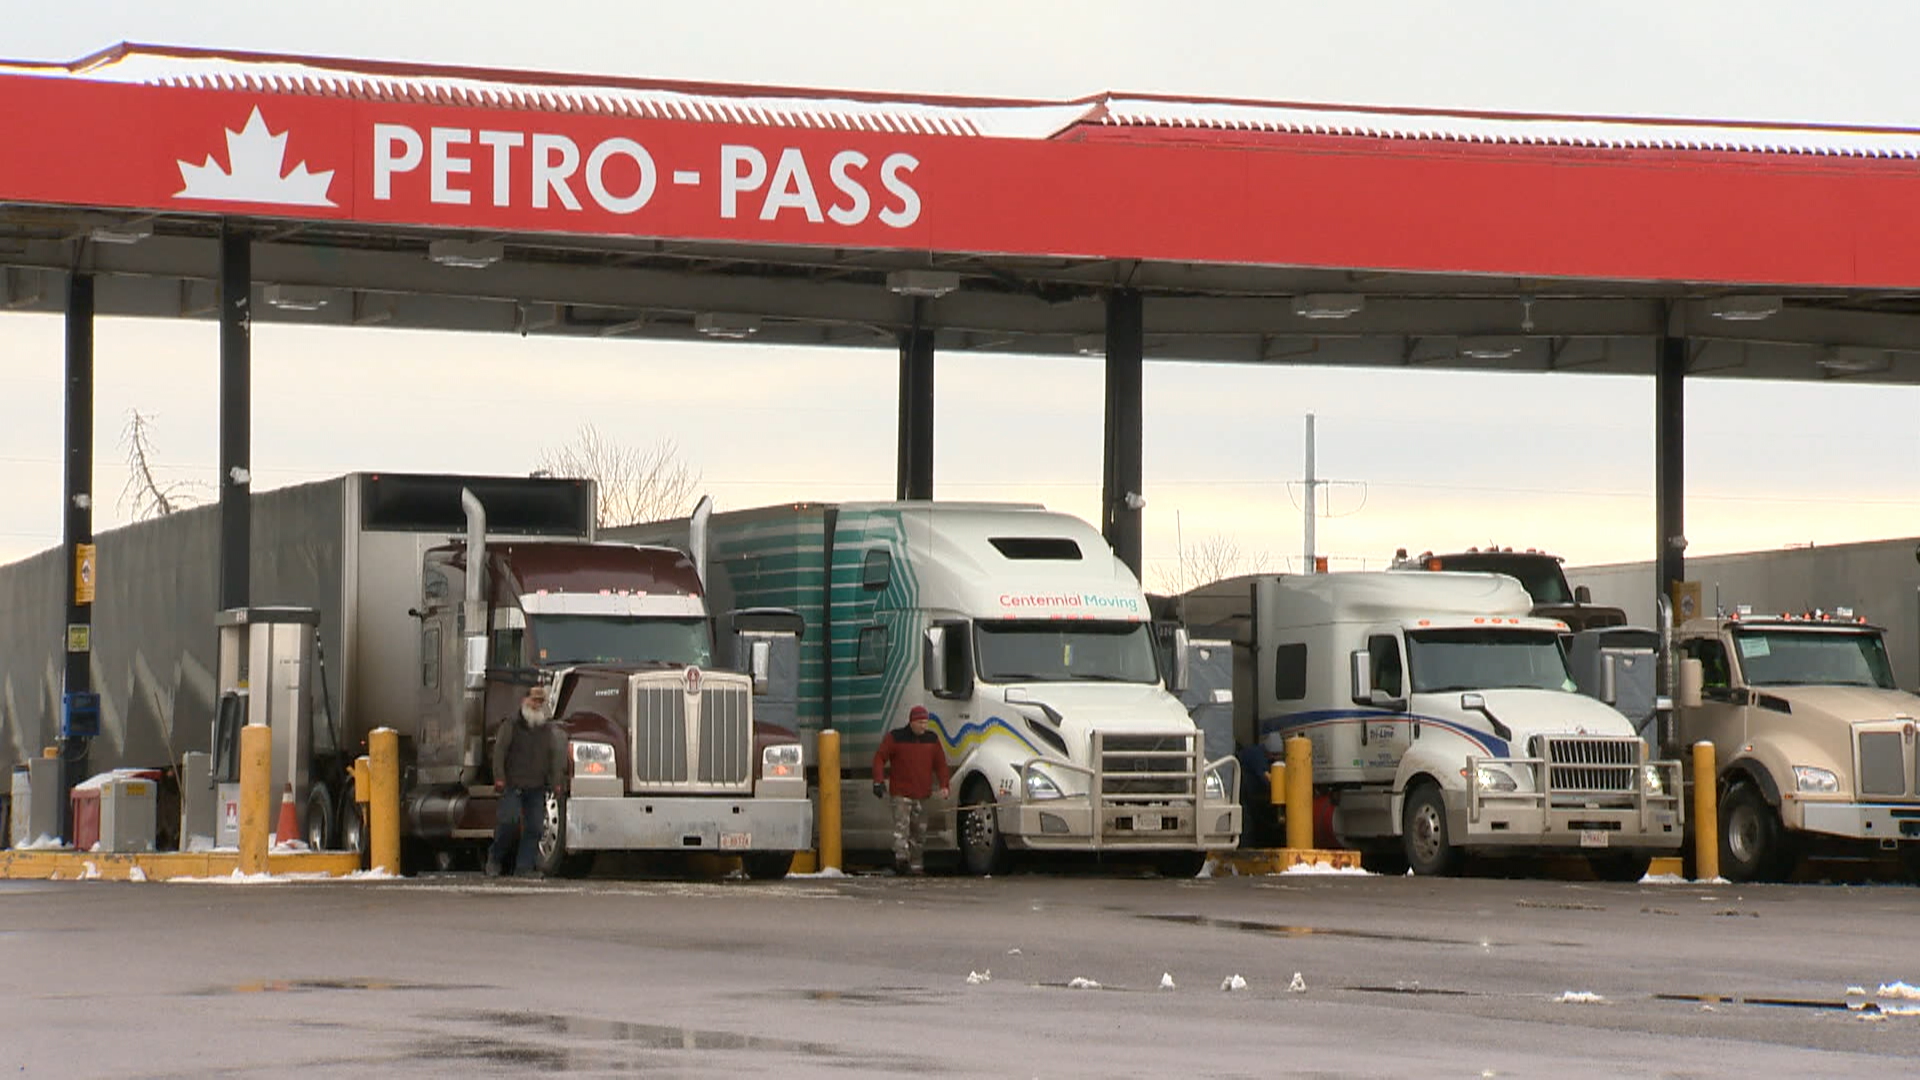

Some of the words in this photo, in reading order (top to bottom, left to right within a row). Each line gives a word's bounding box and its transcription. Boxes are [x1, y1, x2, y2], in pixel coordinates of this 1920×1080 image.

[999, 593, 1082, 607] Centennial
[1084, 594, 1138, 612] Moving
[999, 778, 1014, 790] 212
